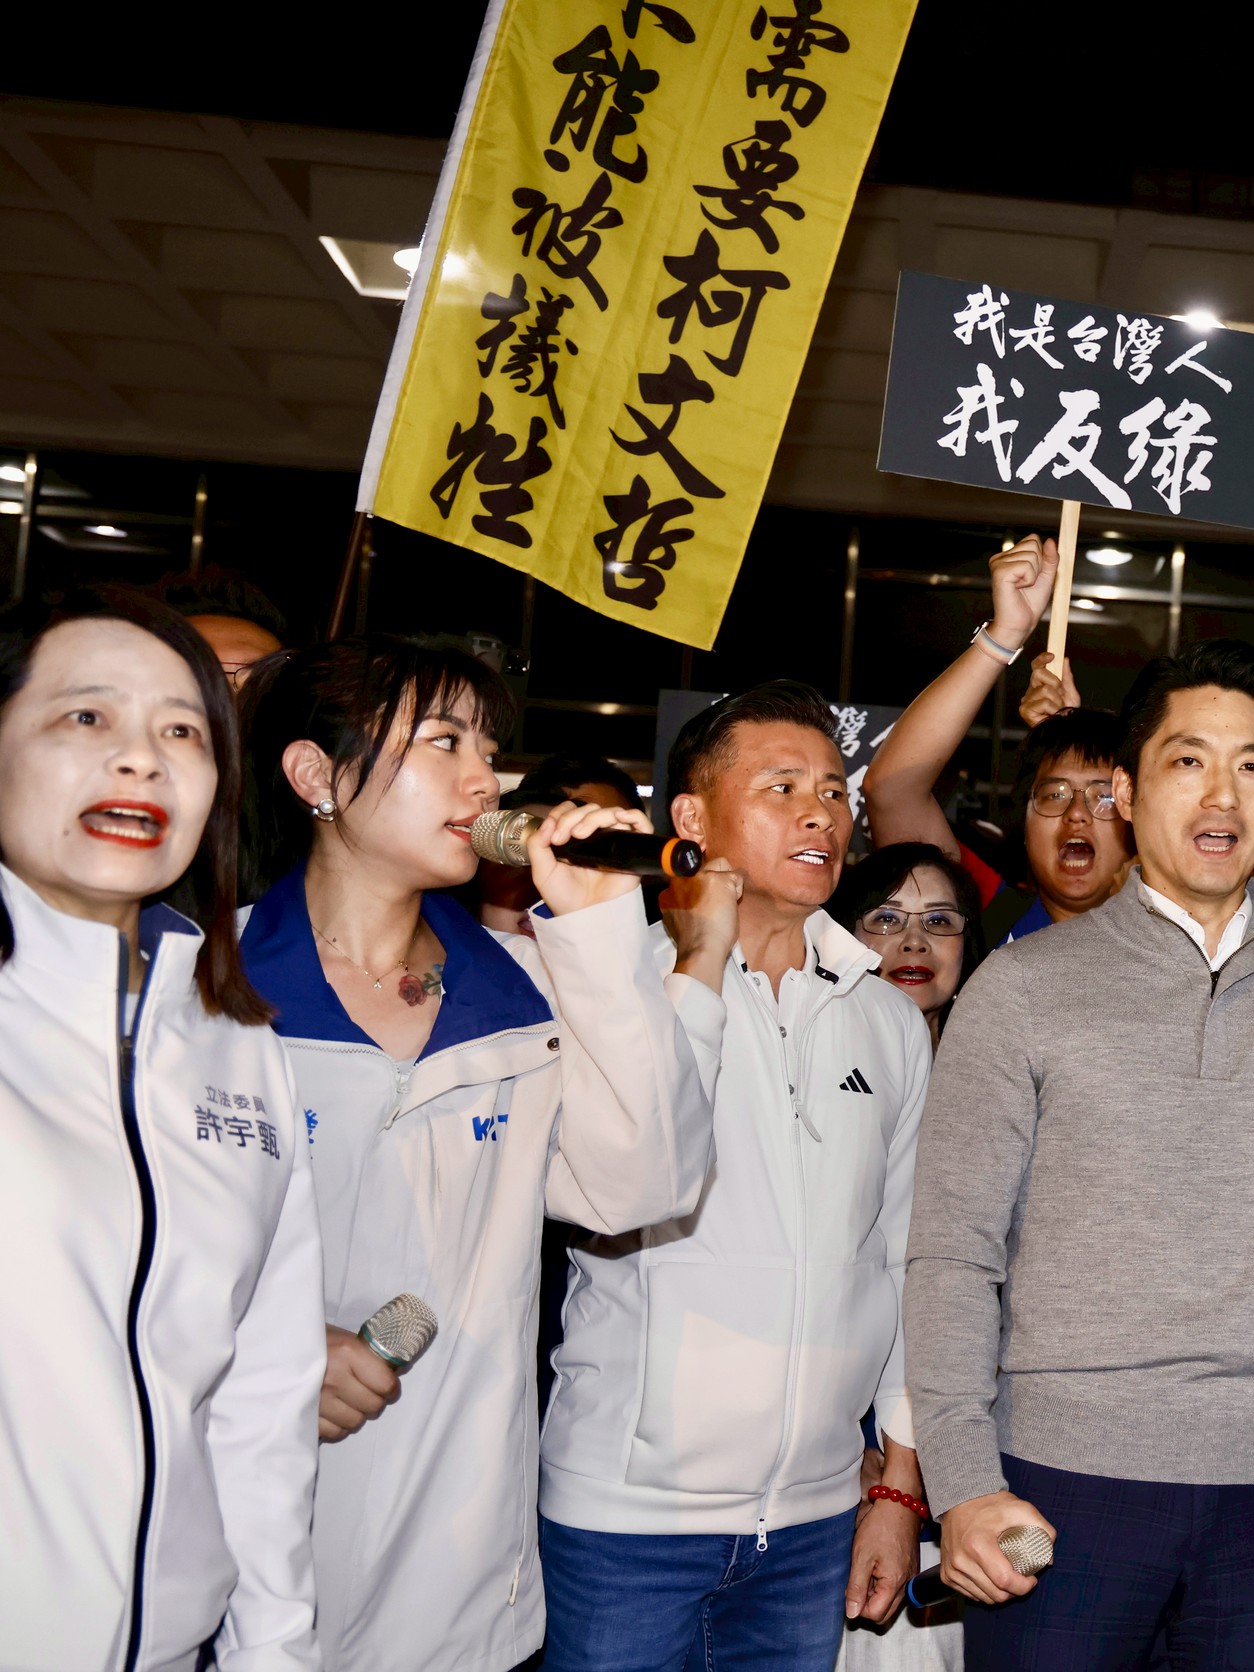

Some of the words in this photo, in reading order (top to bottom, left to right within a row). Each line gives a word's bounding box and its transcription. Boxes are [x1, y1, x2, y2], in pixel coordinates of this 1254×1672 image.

[594, 0, 850, 611] 需要柯文哲
[953, 284, 1232, 394] 我是台灣人
[936, 363, 1218, 515] 我反綠
[194, 1104, 280, 1160] 許宇甄
[205, 1084, 267, 1115] 立法委員
